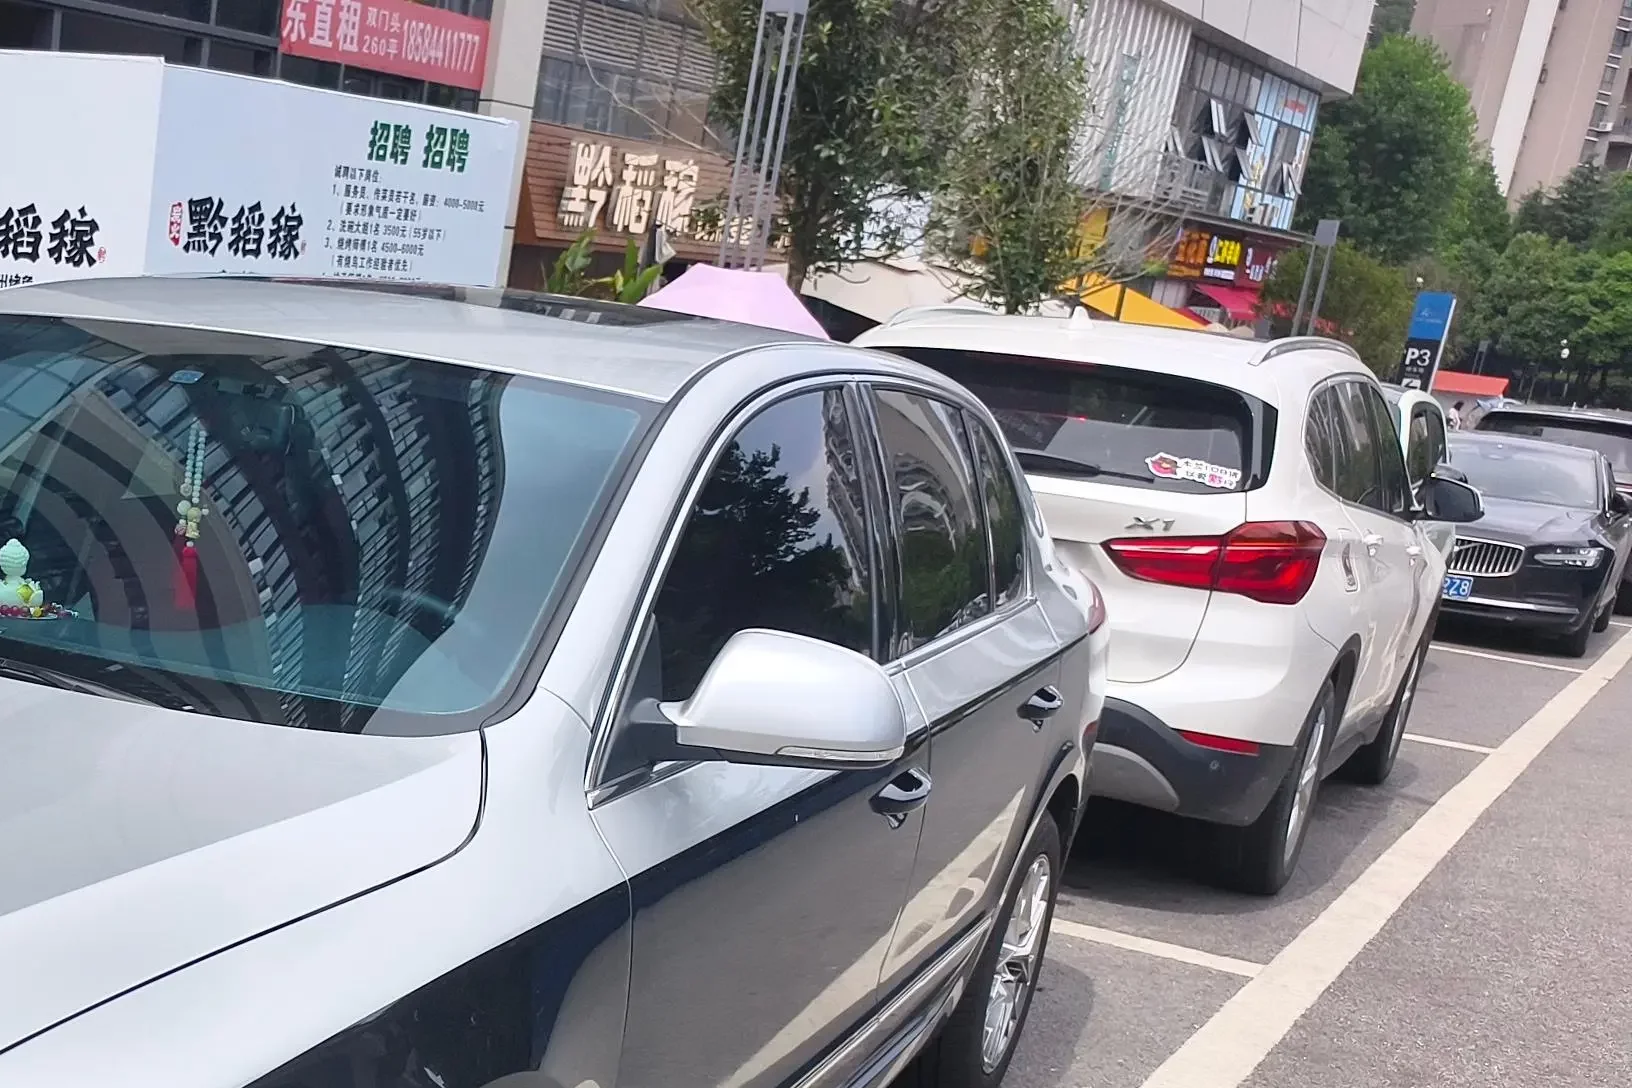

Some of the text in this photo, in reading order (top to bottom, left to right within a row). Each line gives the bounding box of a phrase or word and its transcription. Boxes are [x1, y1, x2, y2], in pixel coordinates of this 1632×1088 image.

[366, 7, 402, 33] 双门头
[362, 35, 399, 60] 260平
[401, 18, 480, 73] 18584411777
[367, 120, 470, 173] 招聘 招聘
[183, 196, 303, 260] 黔稻稼
[1404, 347, 1431, 366] P3
